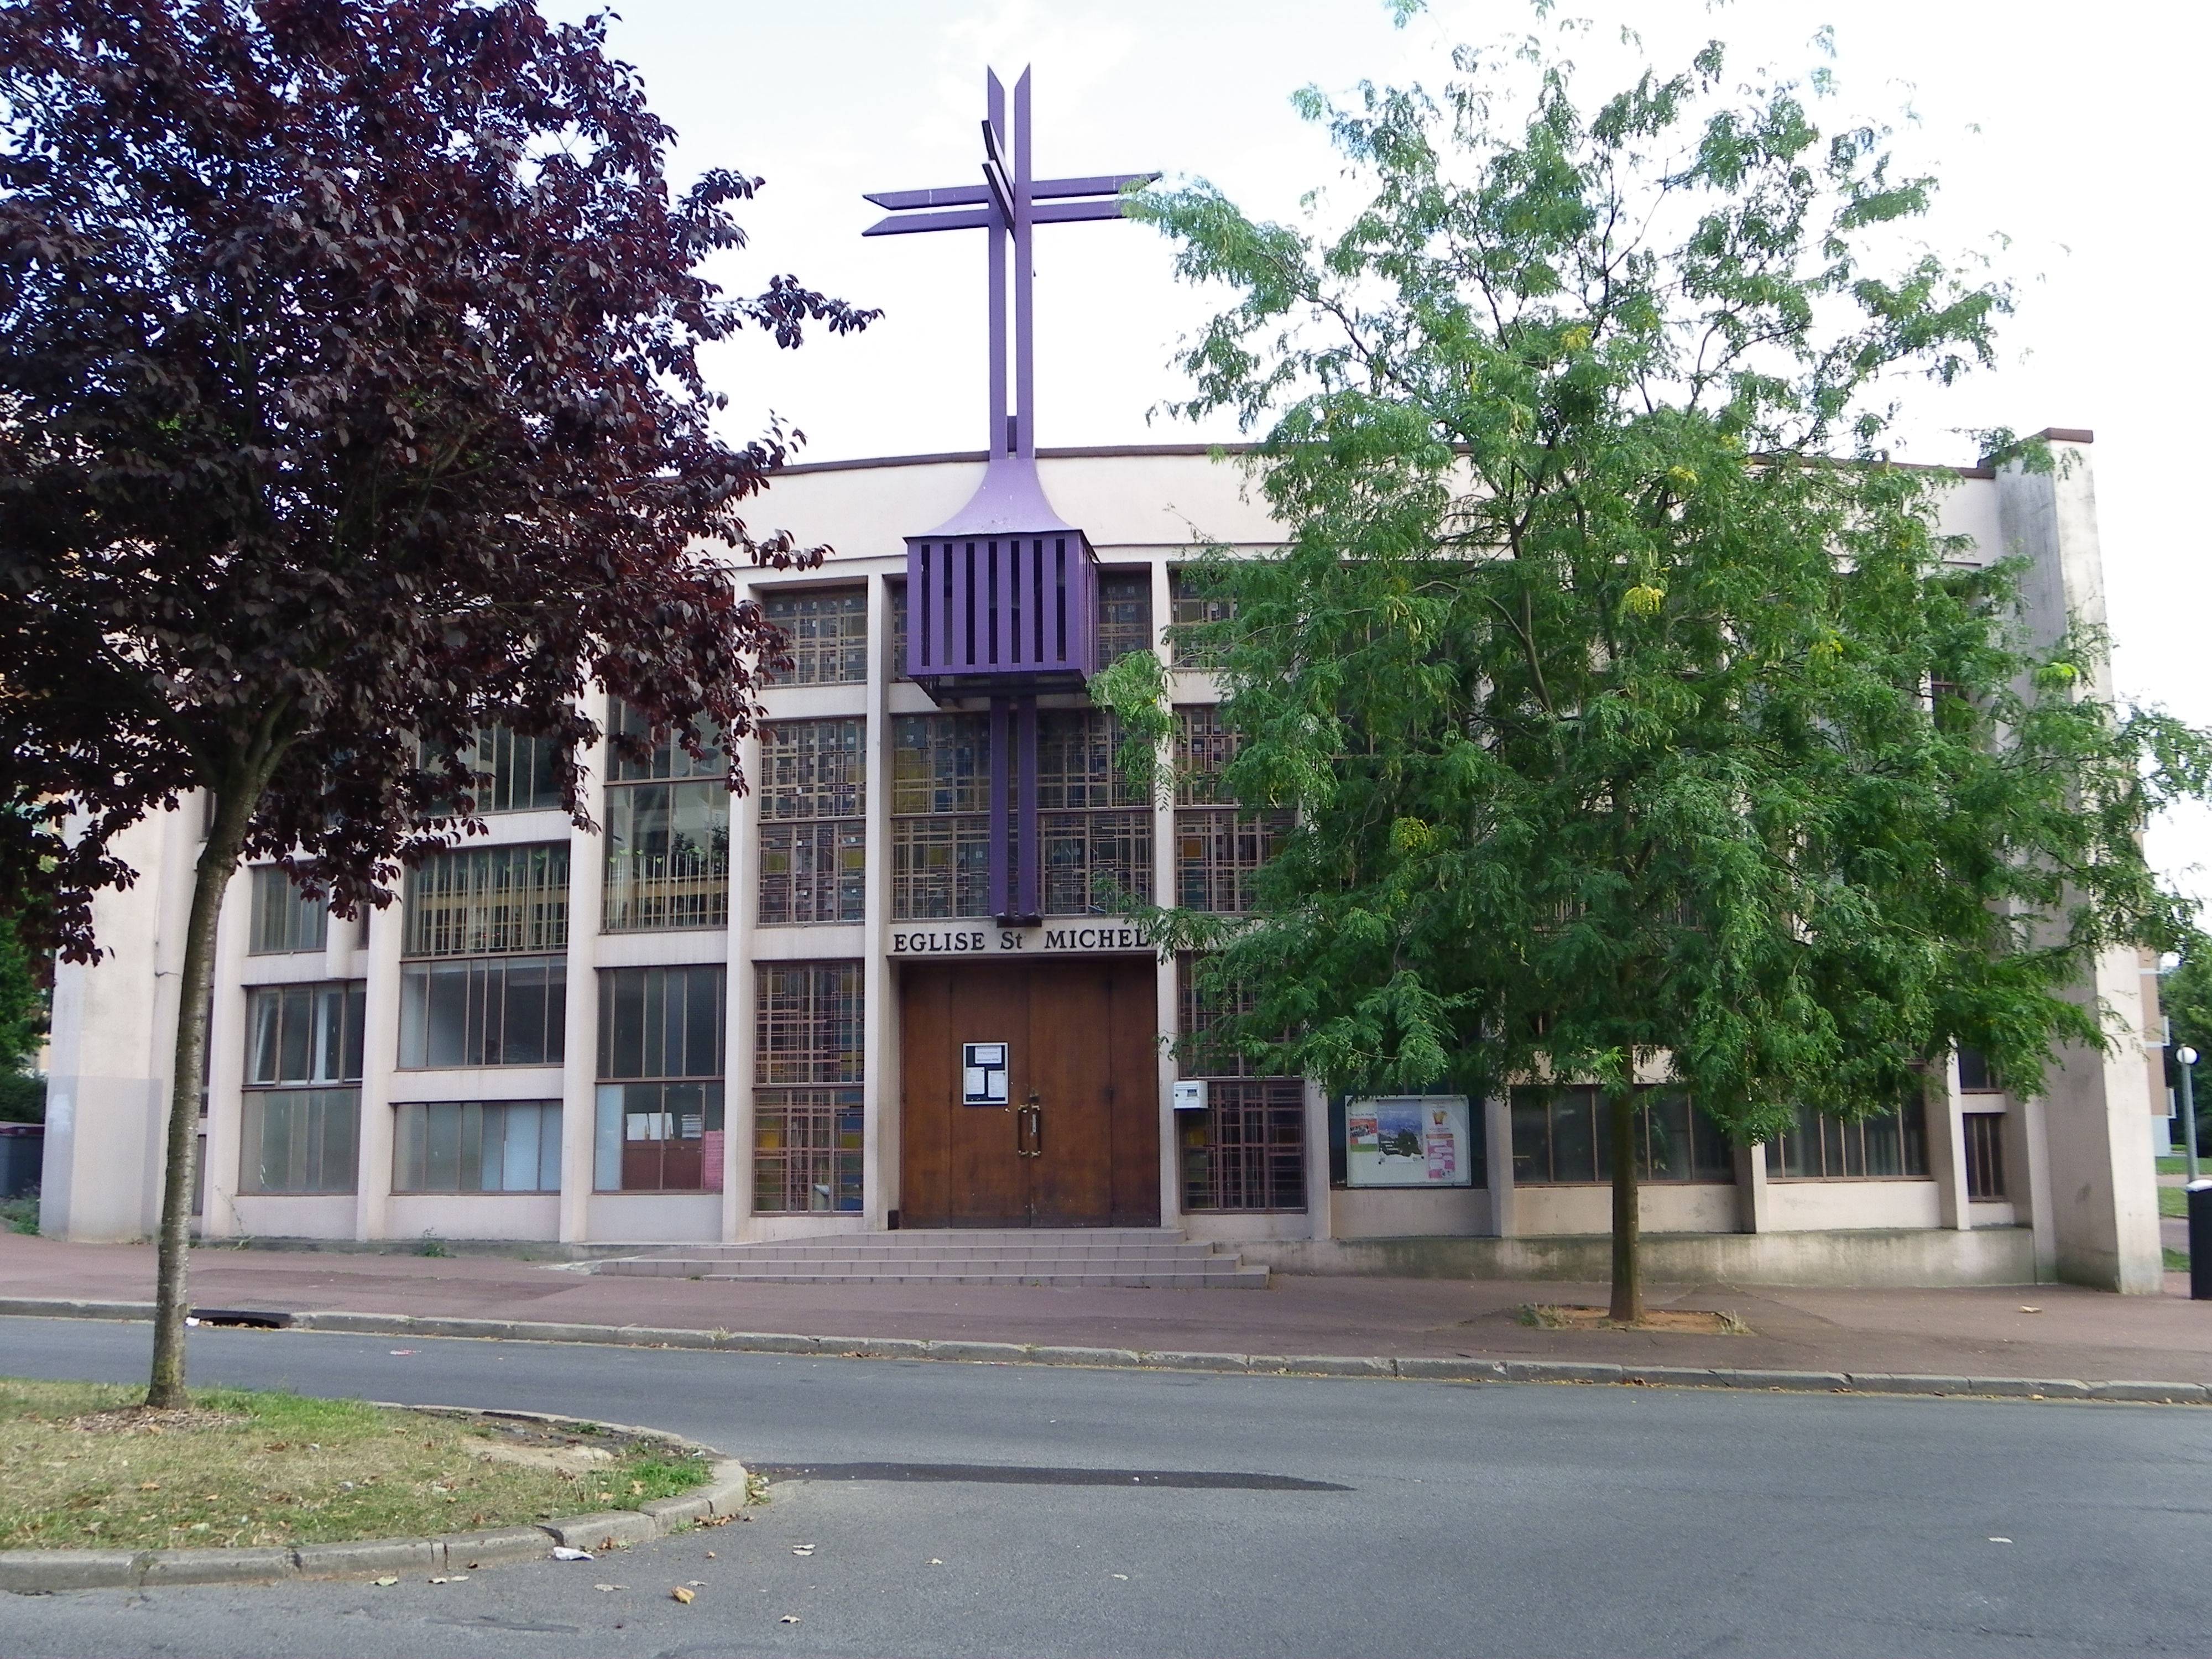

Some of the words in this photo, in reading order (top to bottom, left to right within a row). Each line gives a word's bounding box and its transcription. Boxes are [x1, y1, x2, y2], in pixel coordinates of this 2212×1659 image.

[894, 933, 985, 952] EGLISE
[1000, 931, 1022, 950] St
[1045, 928, 1150, 950] MICHEL
